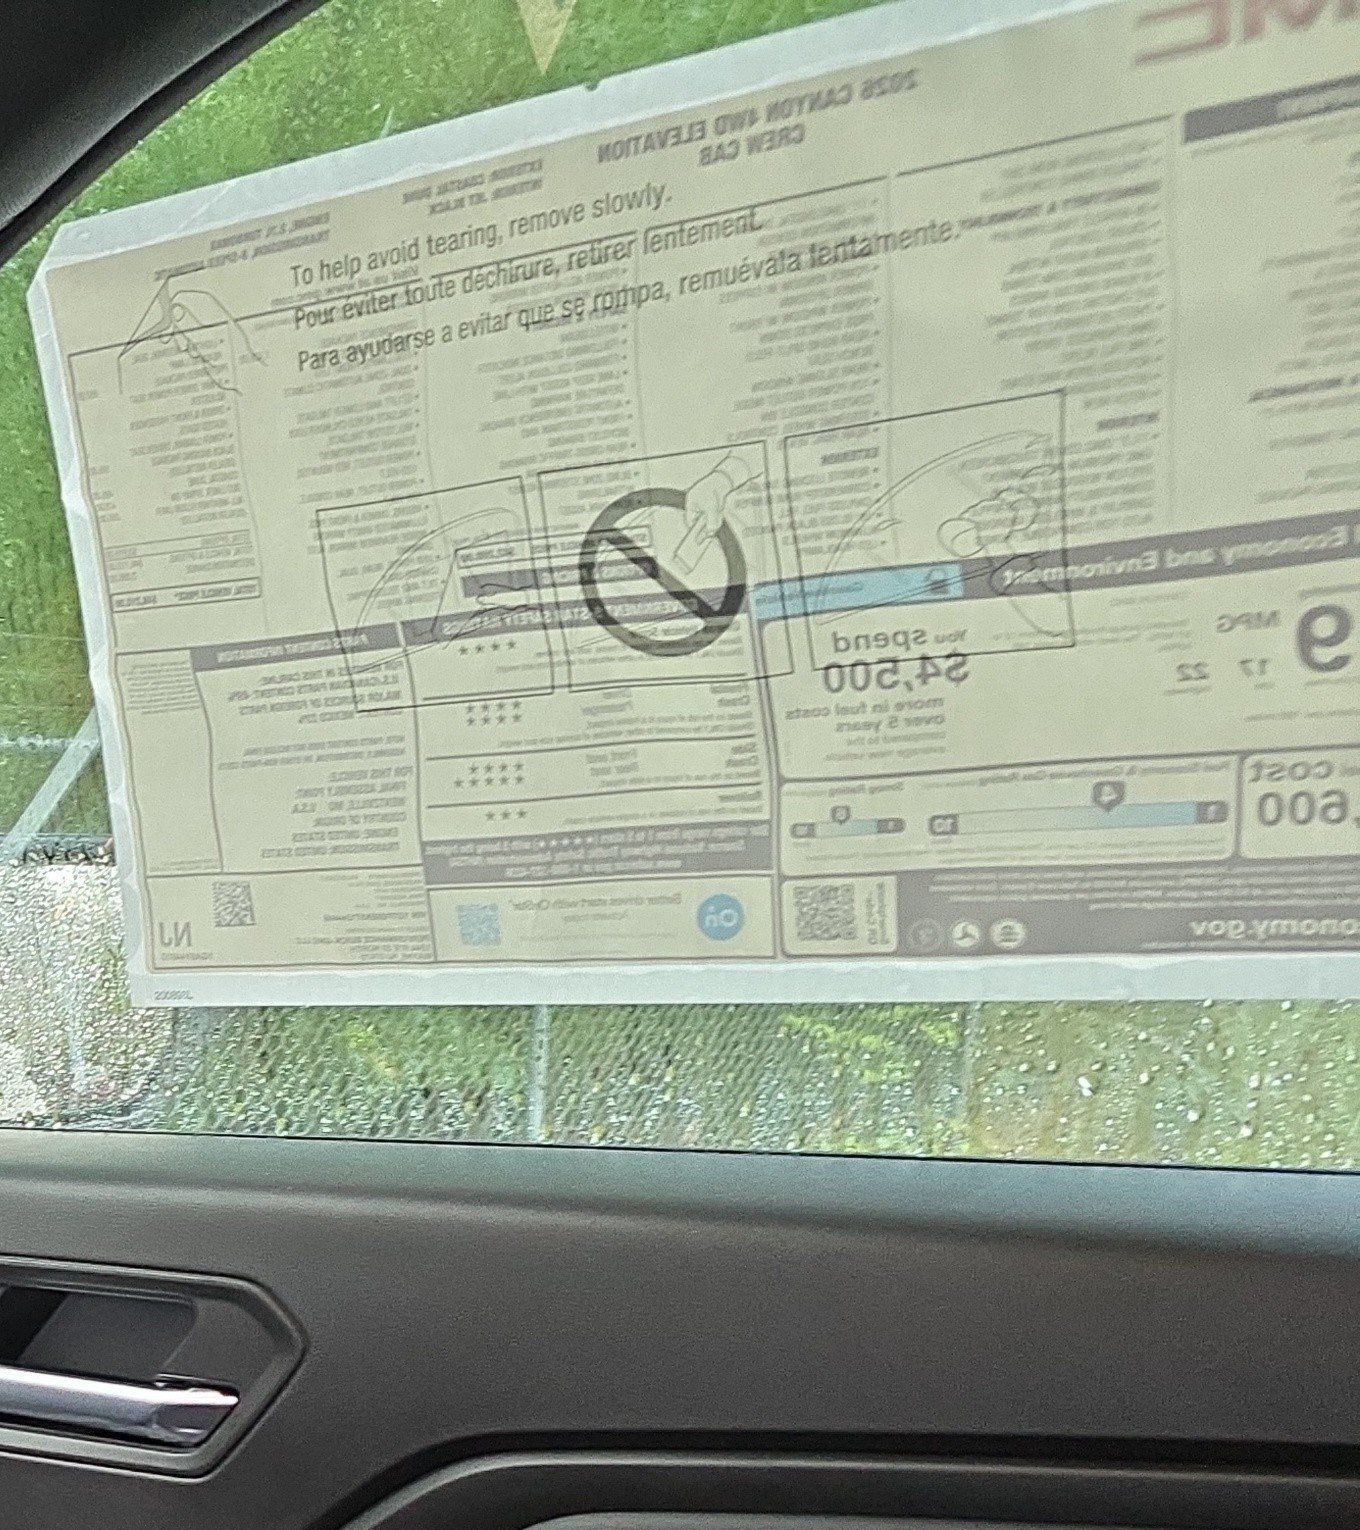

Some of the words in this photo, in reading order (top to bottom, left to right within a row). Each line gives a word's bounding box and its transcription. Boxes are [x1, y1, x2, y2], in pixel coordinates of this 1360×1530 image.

[290, 261, 315, 288] To
[318, 250, 363, 285] help
[365, 236, 421, 271] avoid
[426, 217, 503, 261] tearing,
[508, 204, 587, 239] remove
[592, 178, 673, 223] slowly.
[293, 299, 338, 330] Pour
[404, 275, 452, 307] toute
[565, 234, 636, 272] retirer
[297, 343, 340, 372] Para
[344, 324, 437, 369] ayudarse
[440, 325, 453, 344] a
[457, 308, 516, 340] evitar
[516, 303, 557, 334] que
[554, 297, 586, 321] se
[593, 279, 671, 318] rompa,
[808, 214, 961, 270] lentamente.
